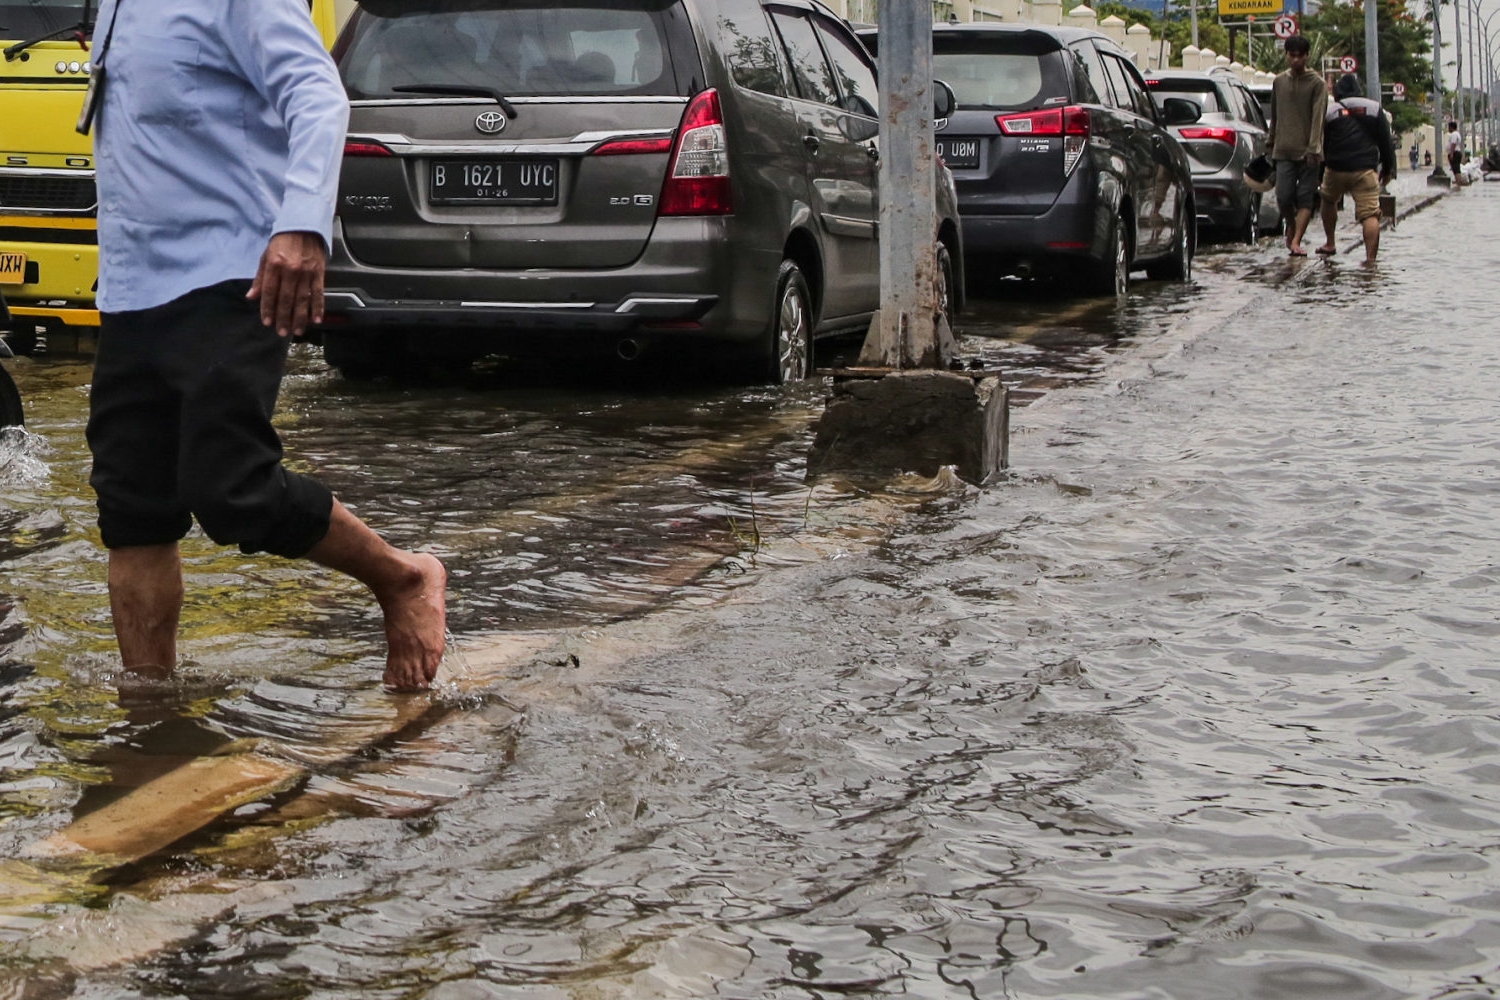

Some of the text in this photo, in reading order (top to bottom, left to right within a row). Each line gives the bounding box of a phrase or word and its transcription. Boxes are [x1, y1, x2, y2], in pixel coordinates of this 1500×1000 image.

[1228, 1, 1273, 9] KENDARAAN
[435, 165, 553, 186] B 1621 UYC
